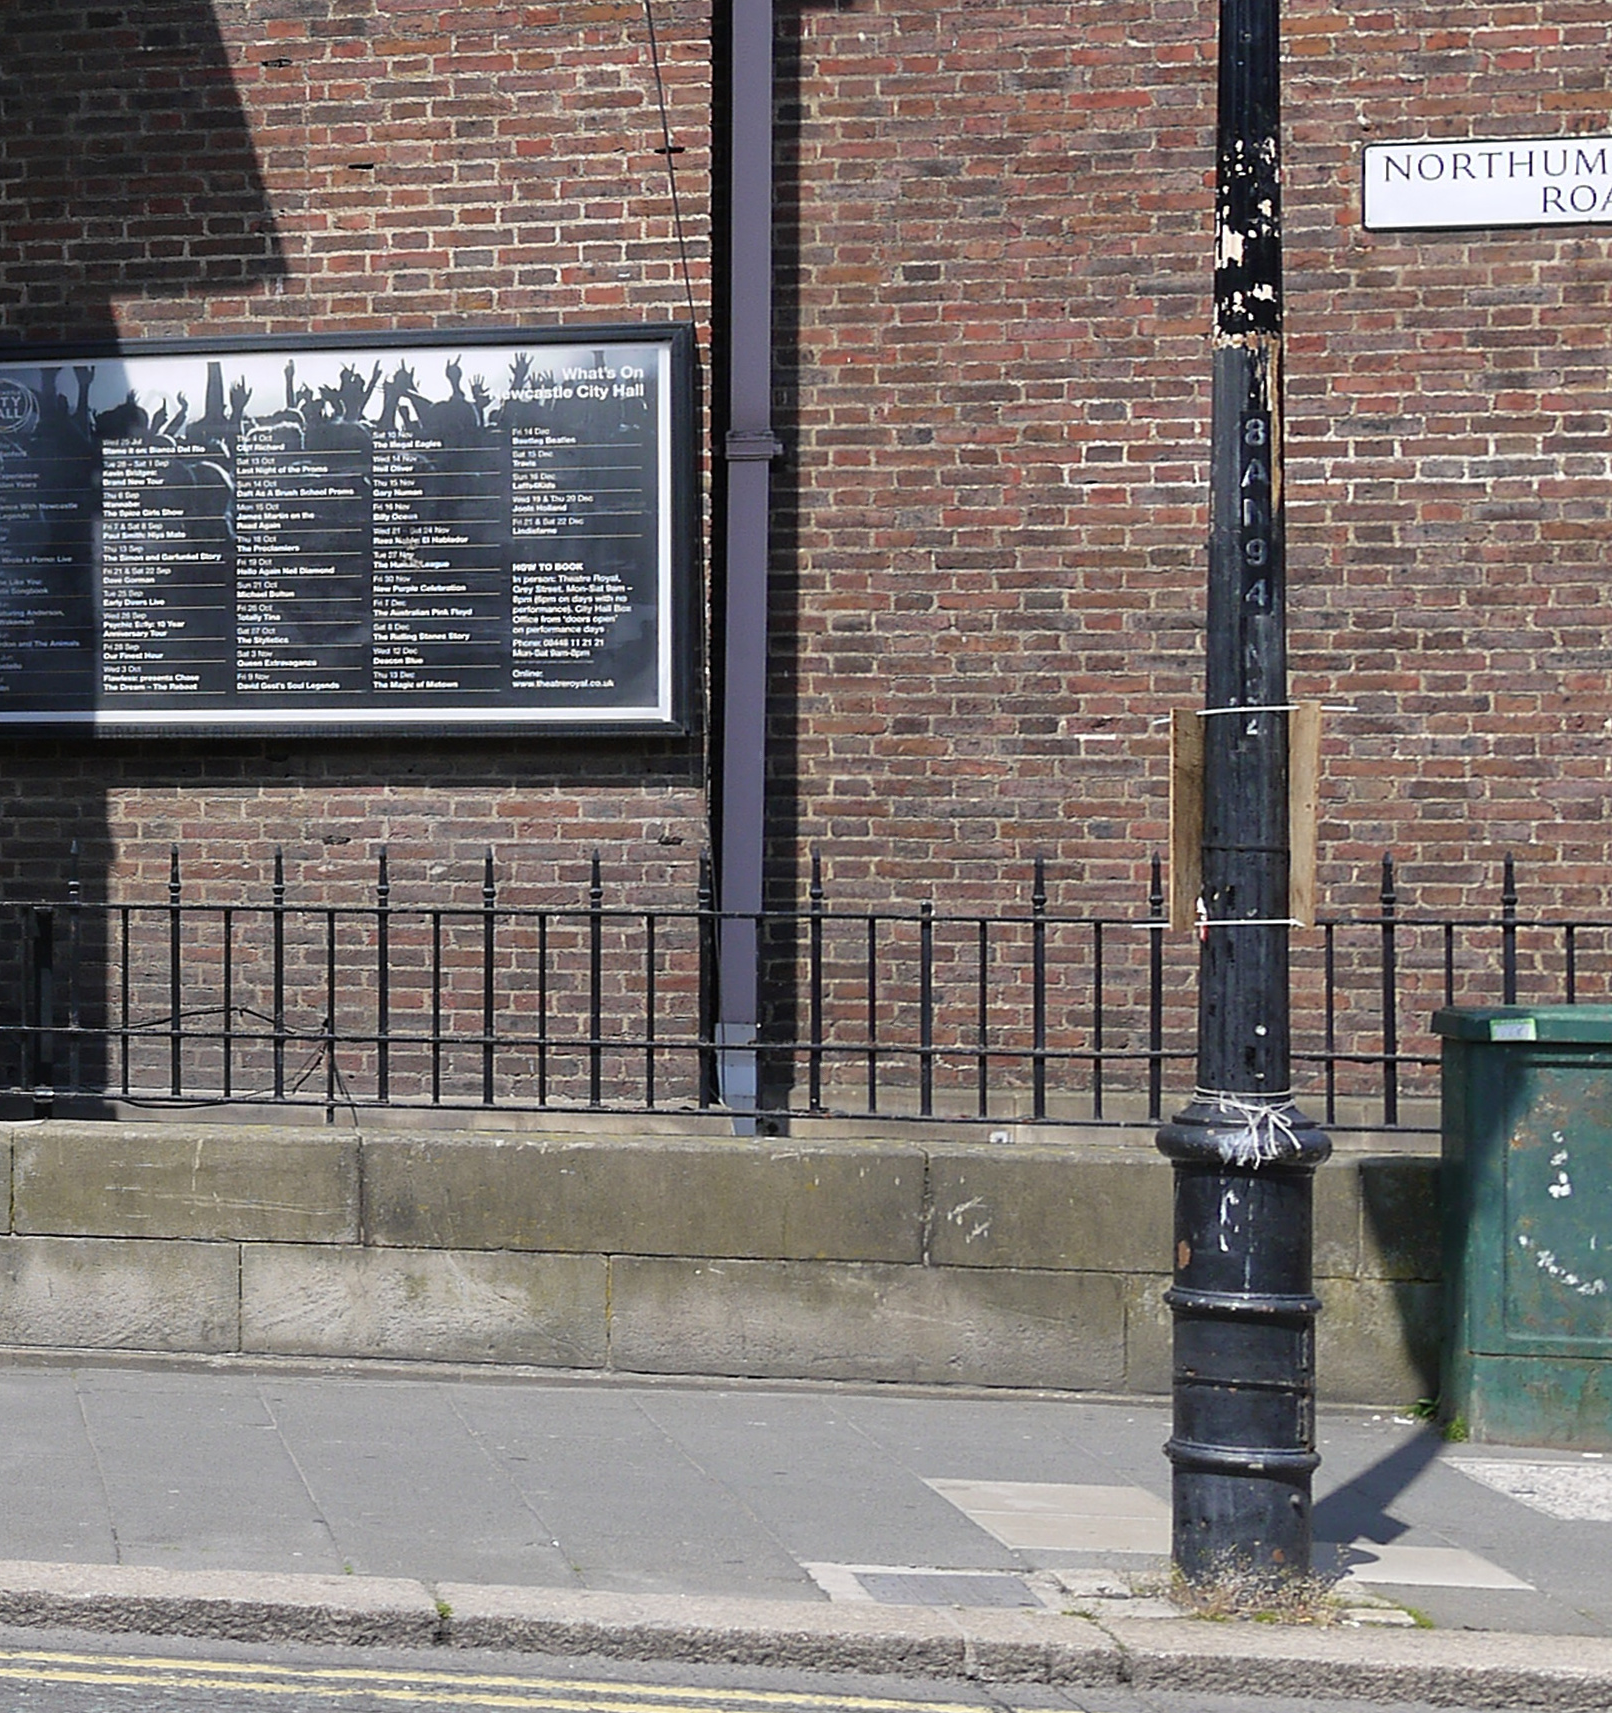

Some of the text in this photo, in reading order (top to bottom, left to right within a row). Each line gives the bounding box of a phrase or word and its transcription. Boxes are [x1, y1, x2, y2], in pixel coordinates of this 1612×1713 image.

[1383, 148, 1608, 183] NORTHUM
[562, 366, 644, 380] What's On
[577, 384, 609, 399] City
[613, 384, 644, 396] Hall
